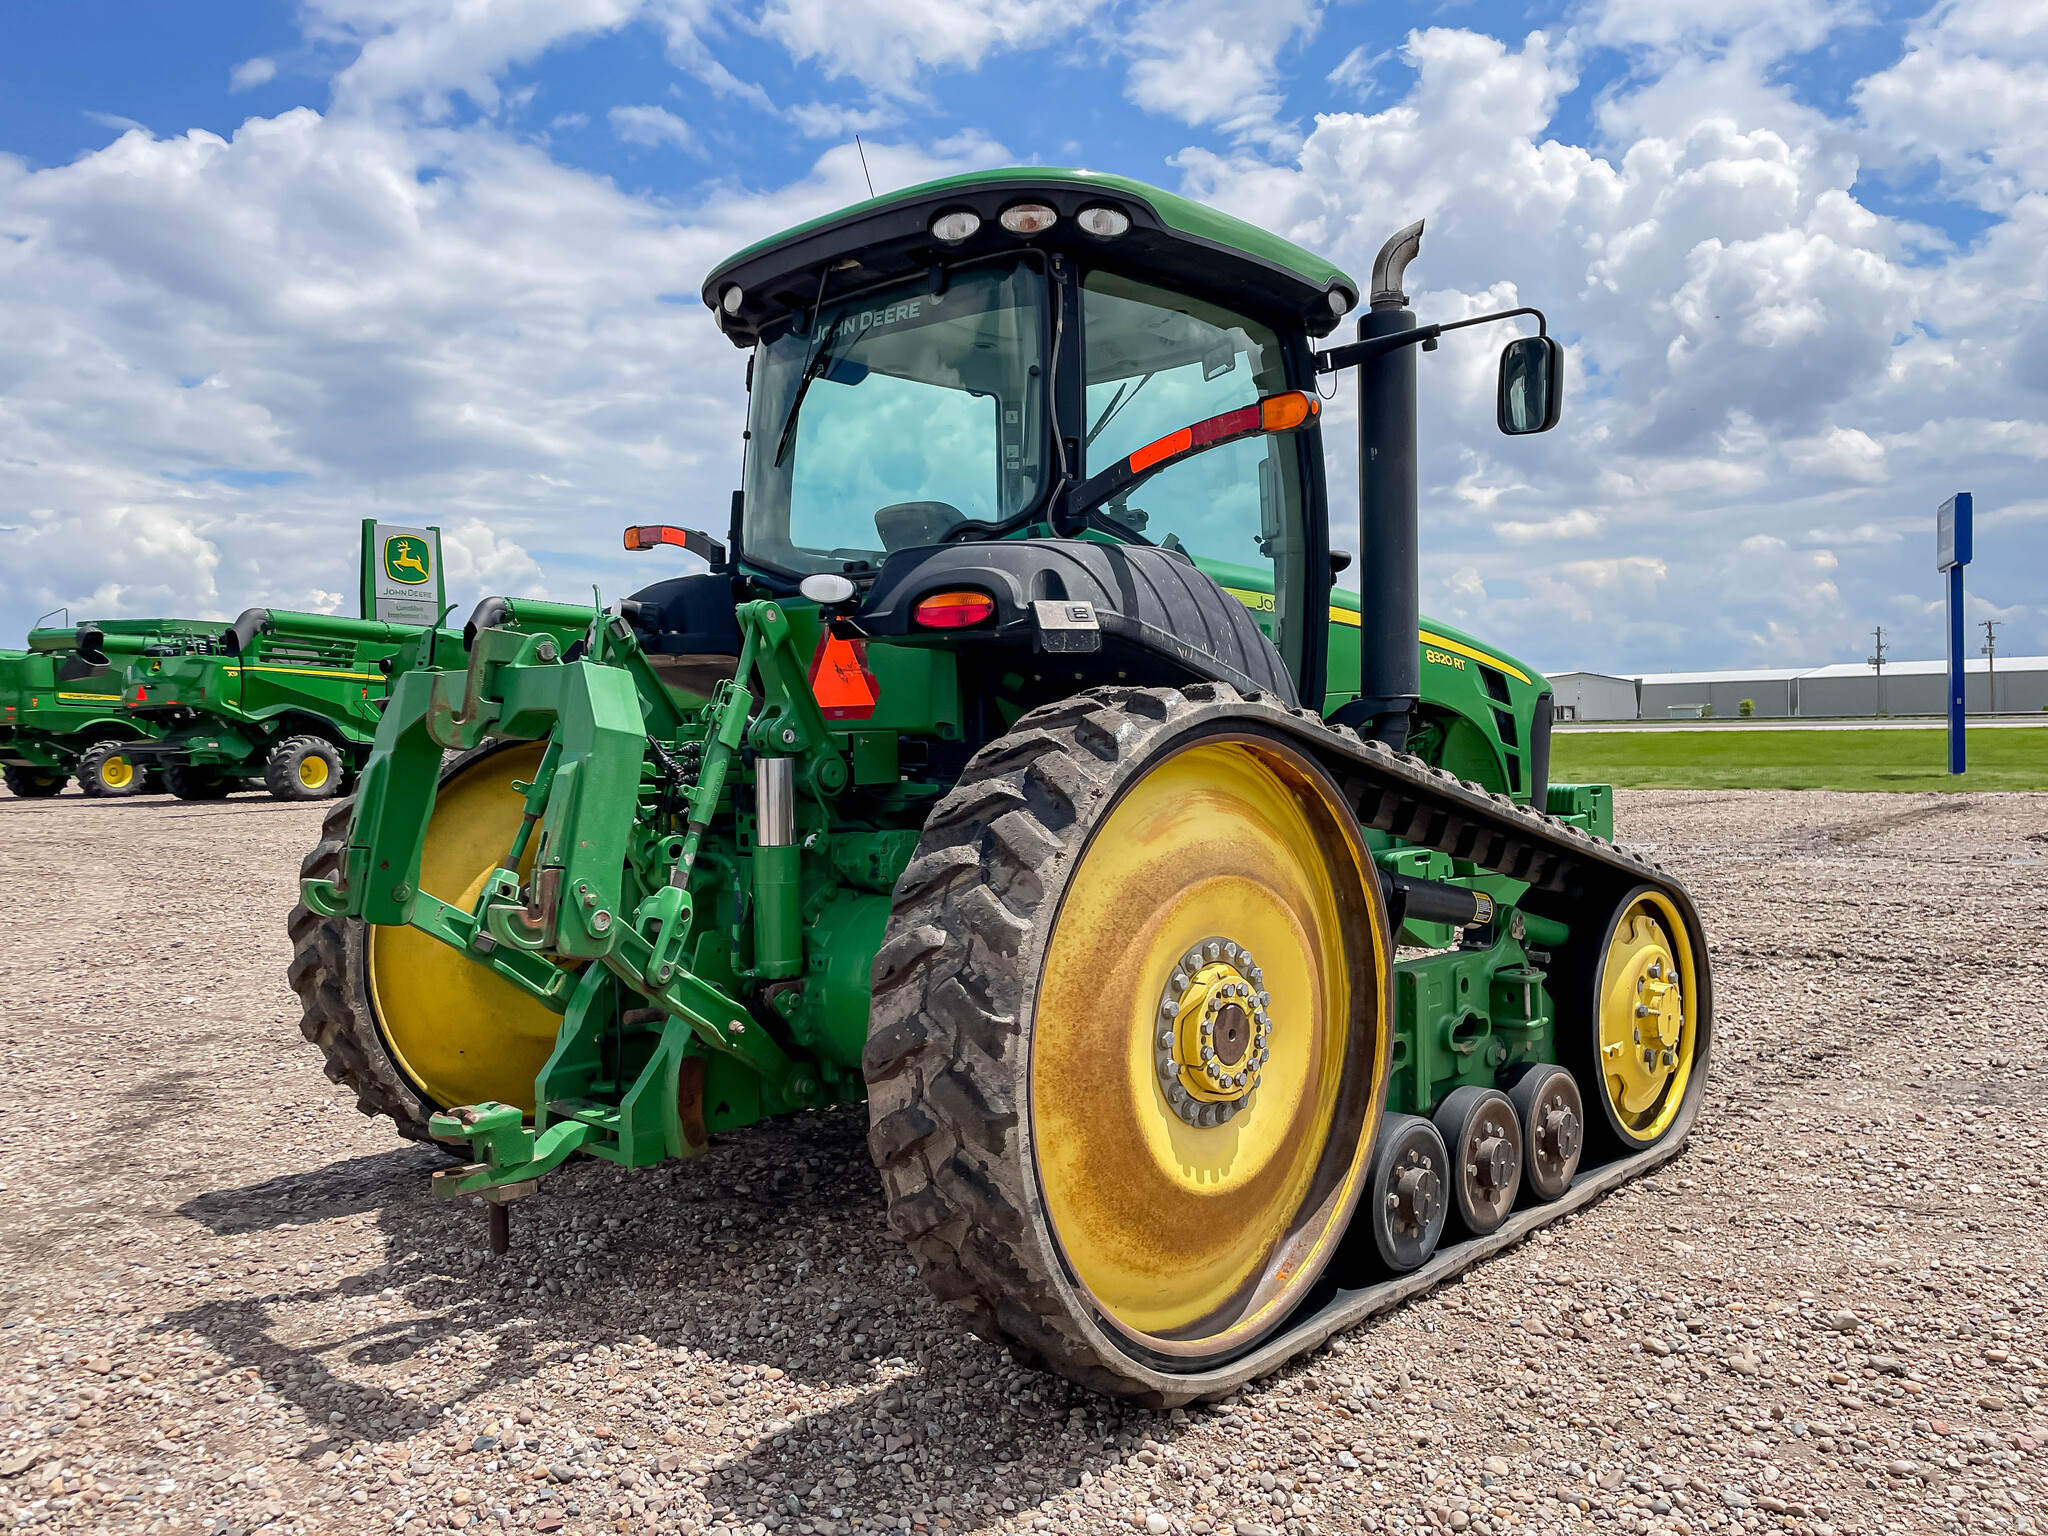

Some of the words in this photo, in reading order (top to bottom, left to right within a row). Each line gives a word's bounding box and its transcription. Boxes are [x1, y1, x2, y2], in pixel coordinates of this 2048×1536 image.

[859, 301, 921, 331] DEERE
[383, 588, 407, 596] JOHN
[407, 589, 433, 599] DEERE
[1425, 649, 1453, 667] 8320
[1453, 657, 1466, 671] RT
